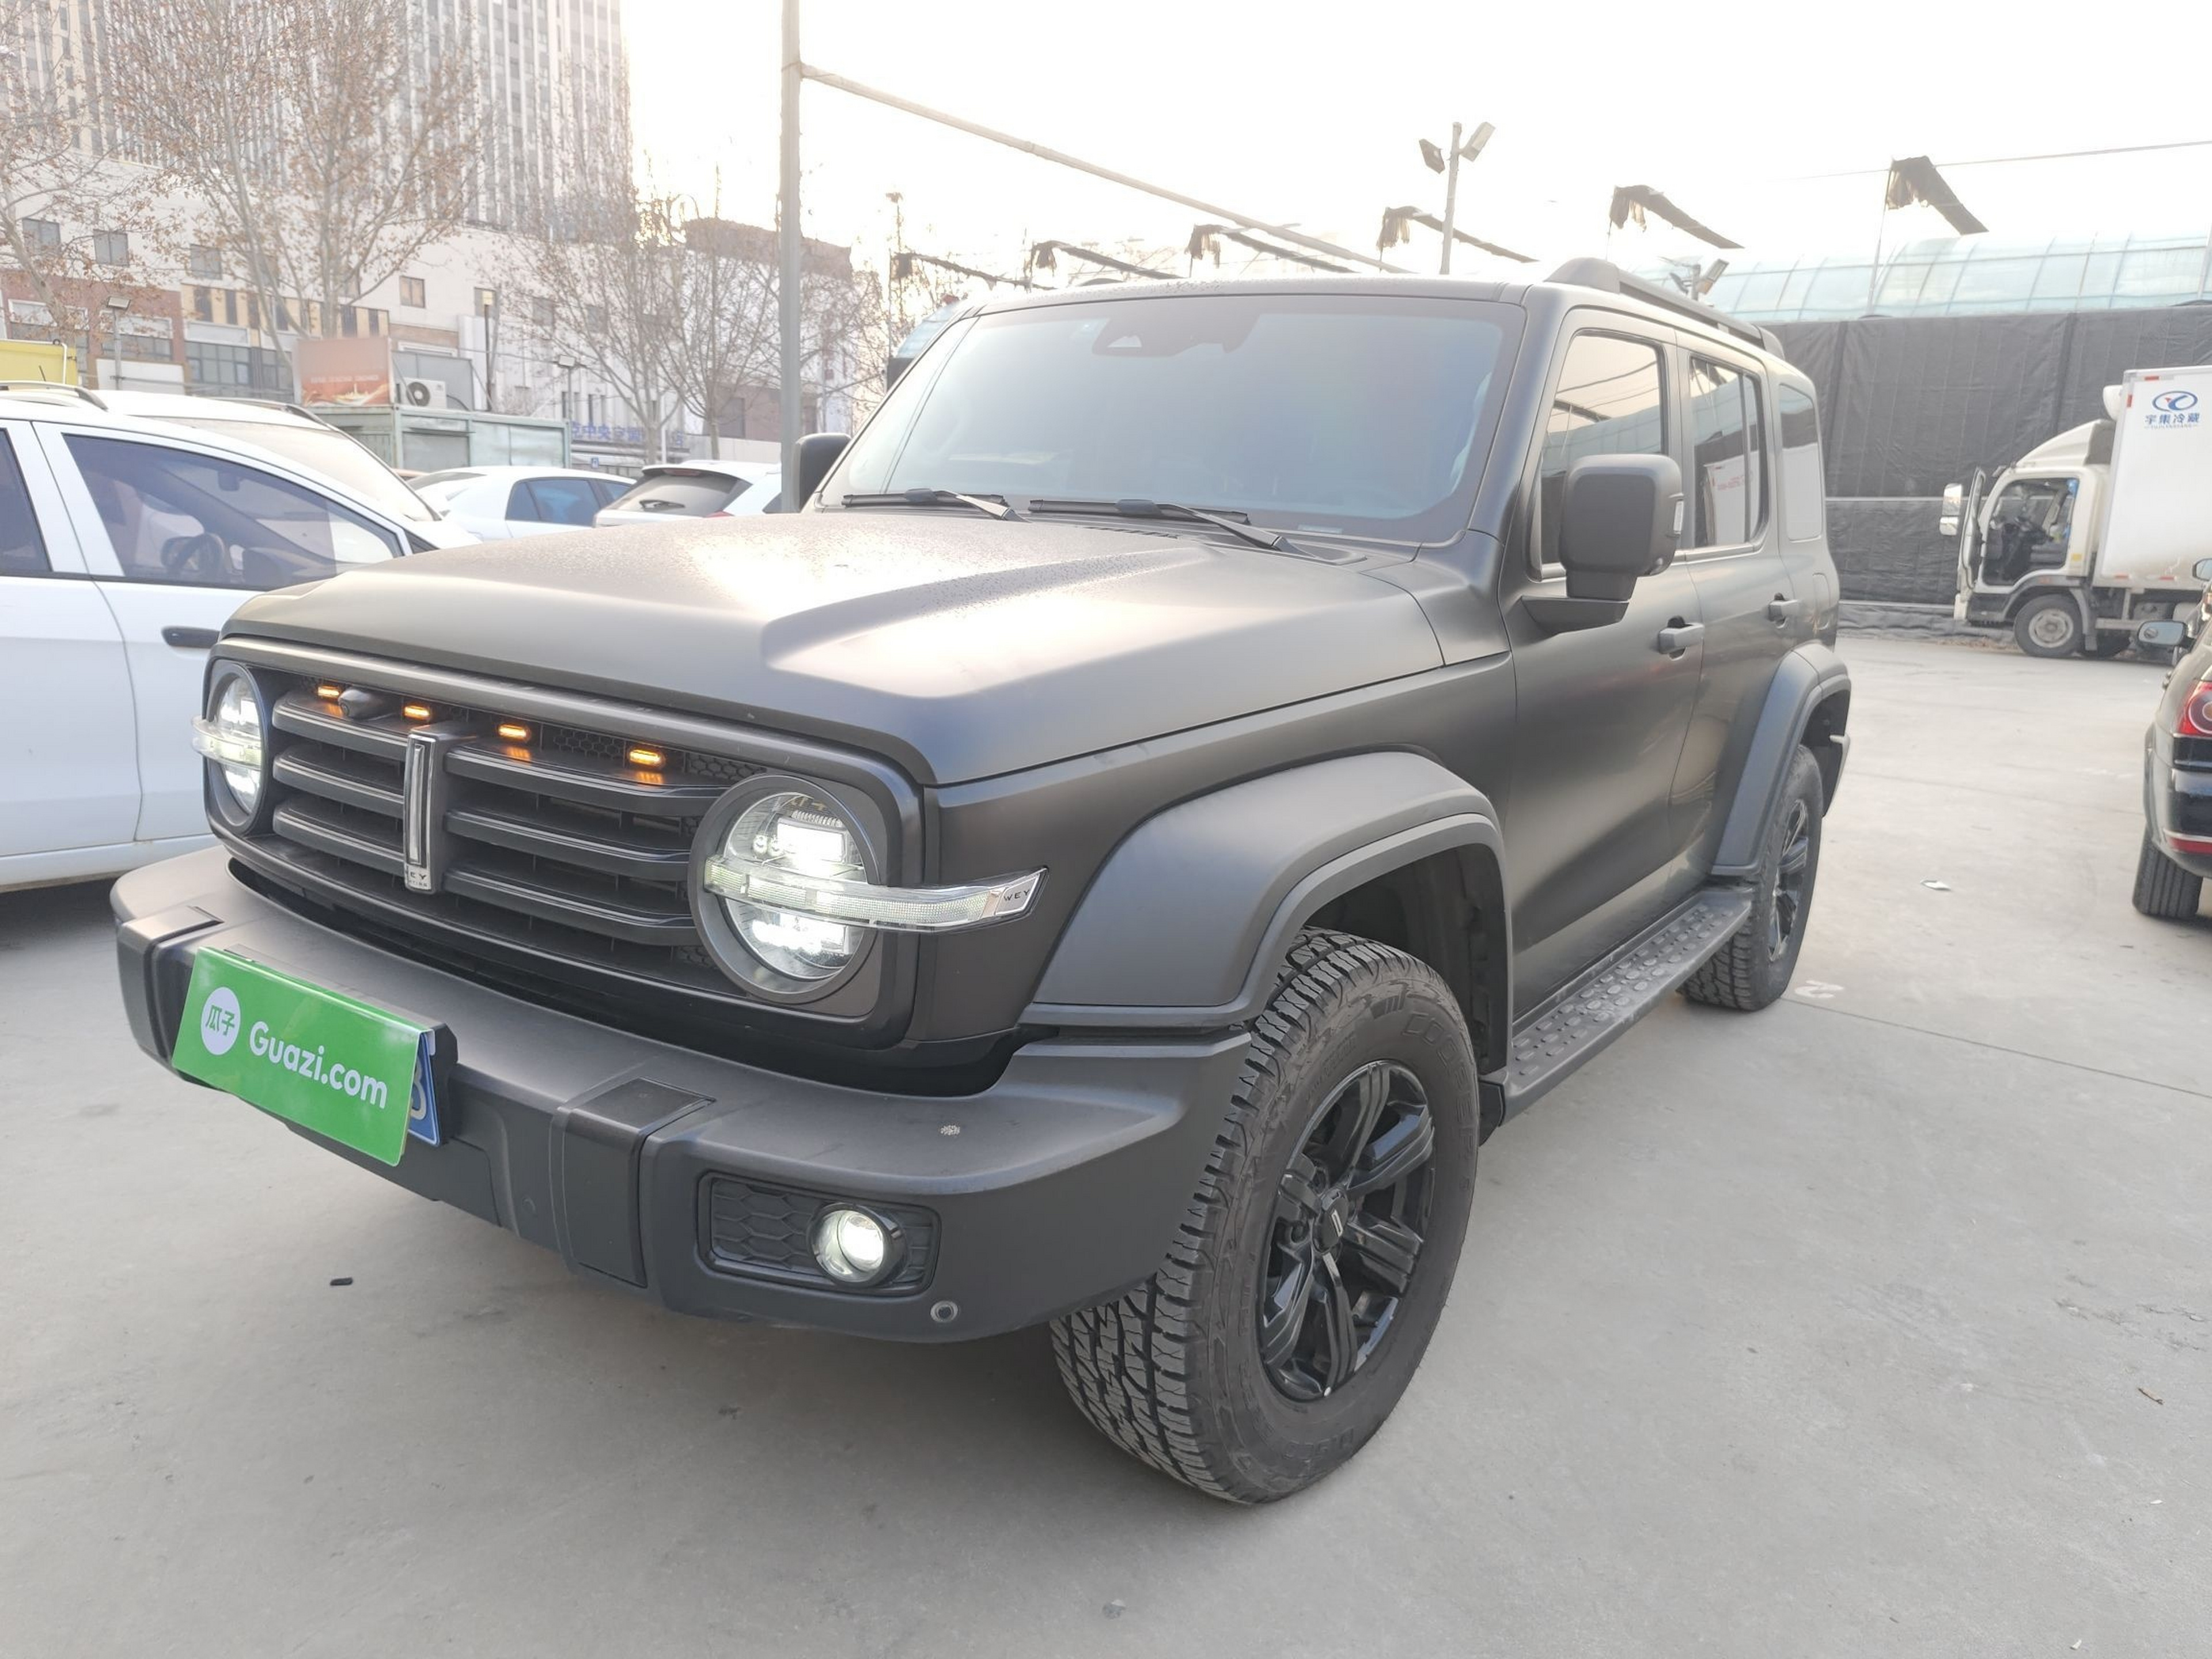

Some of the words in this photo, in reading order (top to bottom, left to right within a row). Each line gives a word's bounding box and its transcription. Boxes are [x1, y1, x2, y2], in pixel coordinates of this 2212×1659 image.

[1003, 889, 1030, 902] WEY
[205, 1005, 235, 1036] 瓜子
[249, 1021, 388, 1109] Guazi.com
